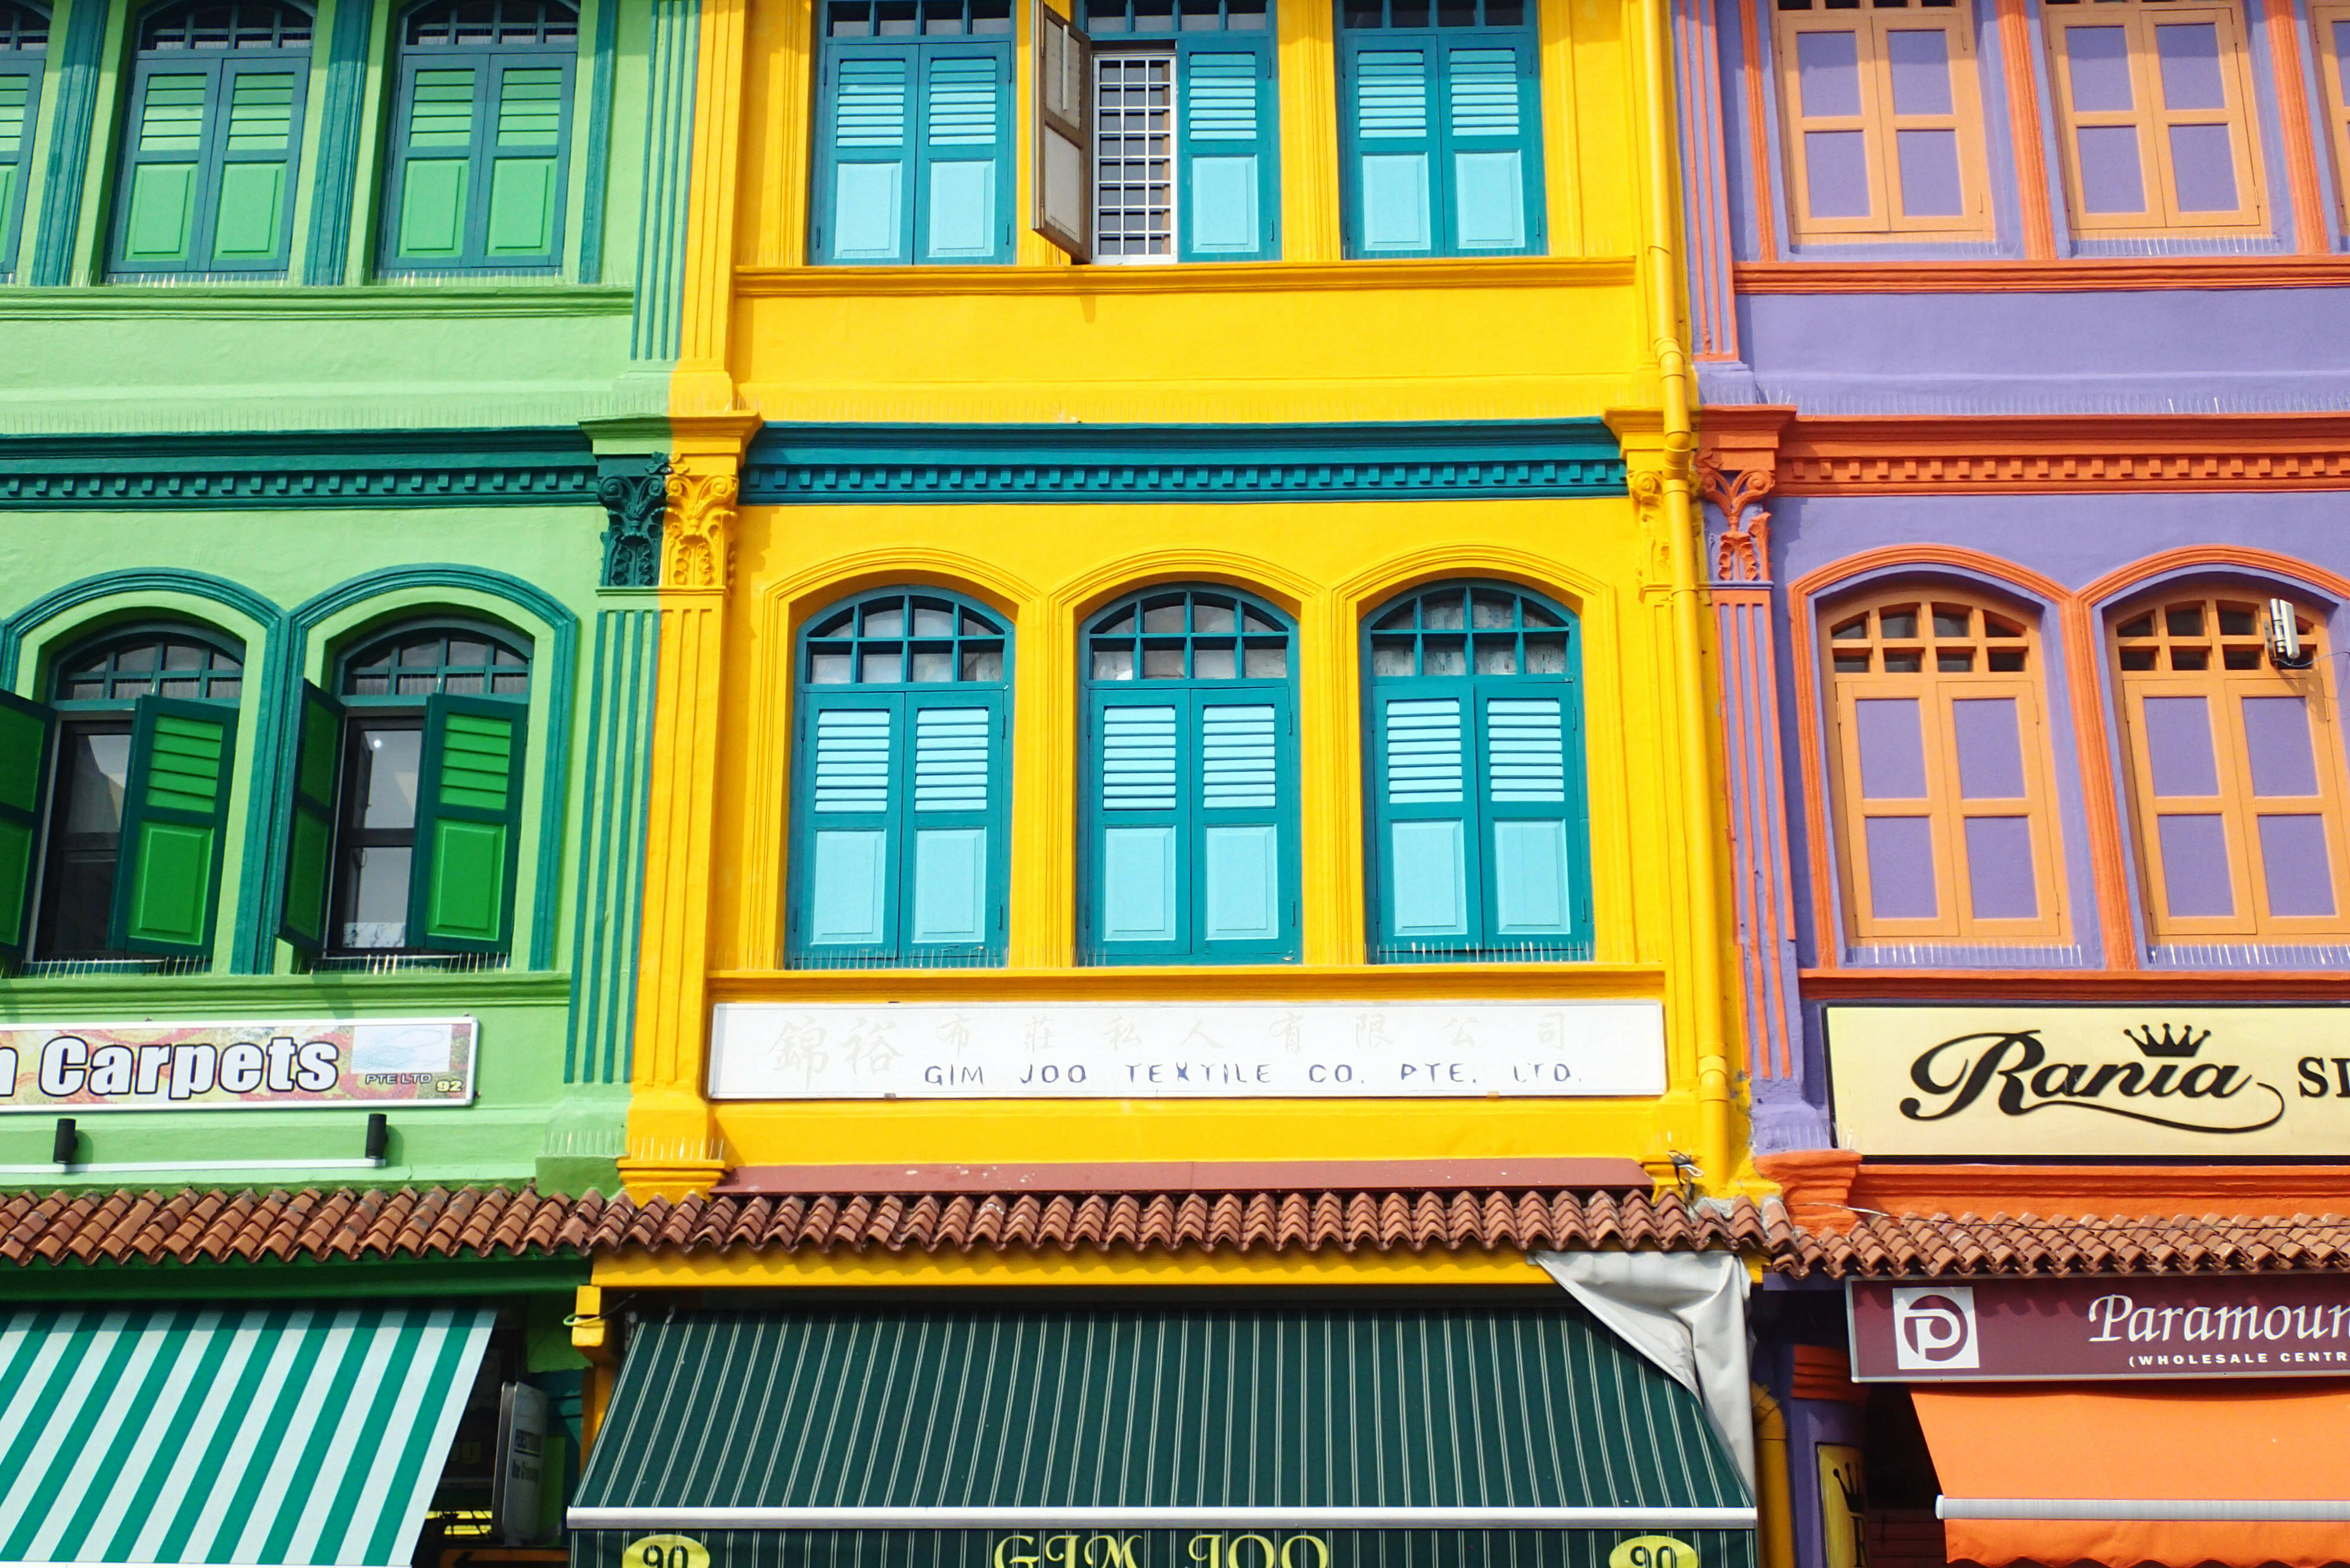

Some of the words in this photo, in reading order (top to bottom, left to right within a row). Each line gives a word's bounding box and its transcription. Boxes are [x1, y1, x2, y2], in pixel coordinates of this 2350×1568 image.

[38, 1036, 339, 1100] Carpets
[365, 1073, 397, 1085] PTE
[400, 1072, 432, 1084] LTD
[924, 1063, 984, 1086] GIM
[1019, 1063, 1087, 1084] JOO
[1126, 1062, 1271, 1084] TEXTILE
[1309, 1063, 1365, 1084] CO.
[1400, 1063, 1477, 1083] PTE.
[1513, 1062, 1582, 1083] LTD.
[435, 1079, 464, 1092] 92
[1899, 1029, 2285, 1134] Rania
[2129, 1352, 2268, 1367] (WHOLESALE
[2280, 1351, 2348, 1363] CENTR
[643, 1544, 689, 1568] 90
[1630, 1545, 1677, 1568] 90
